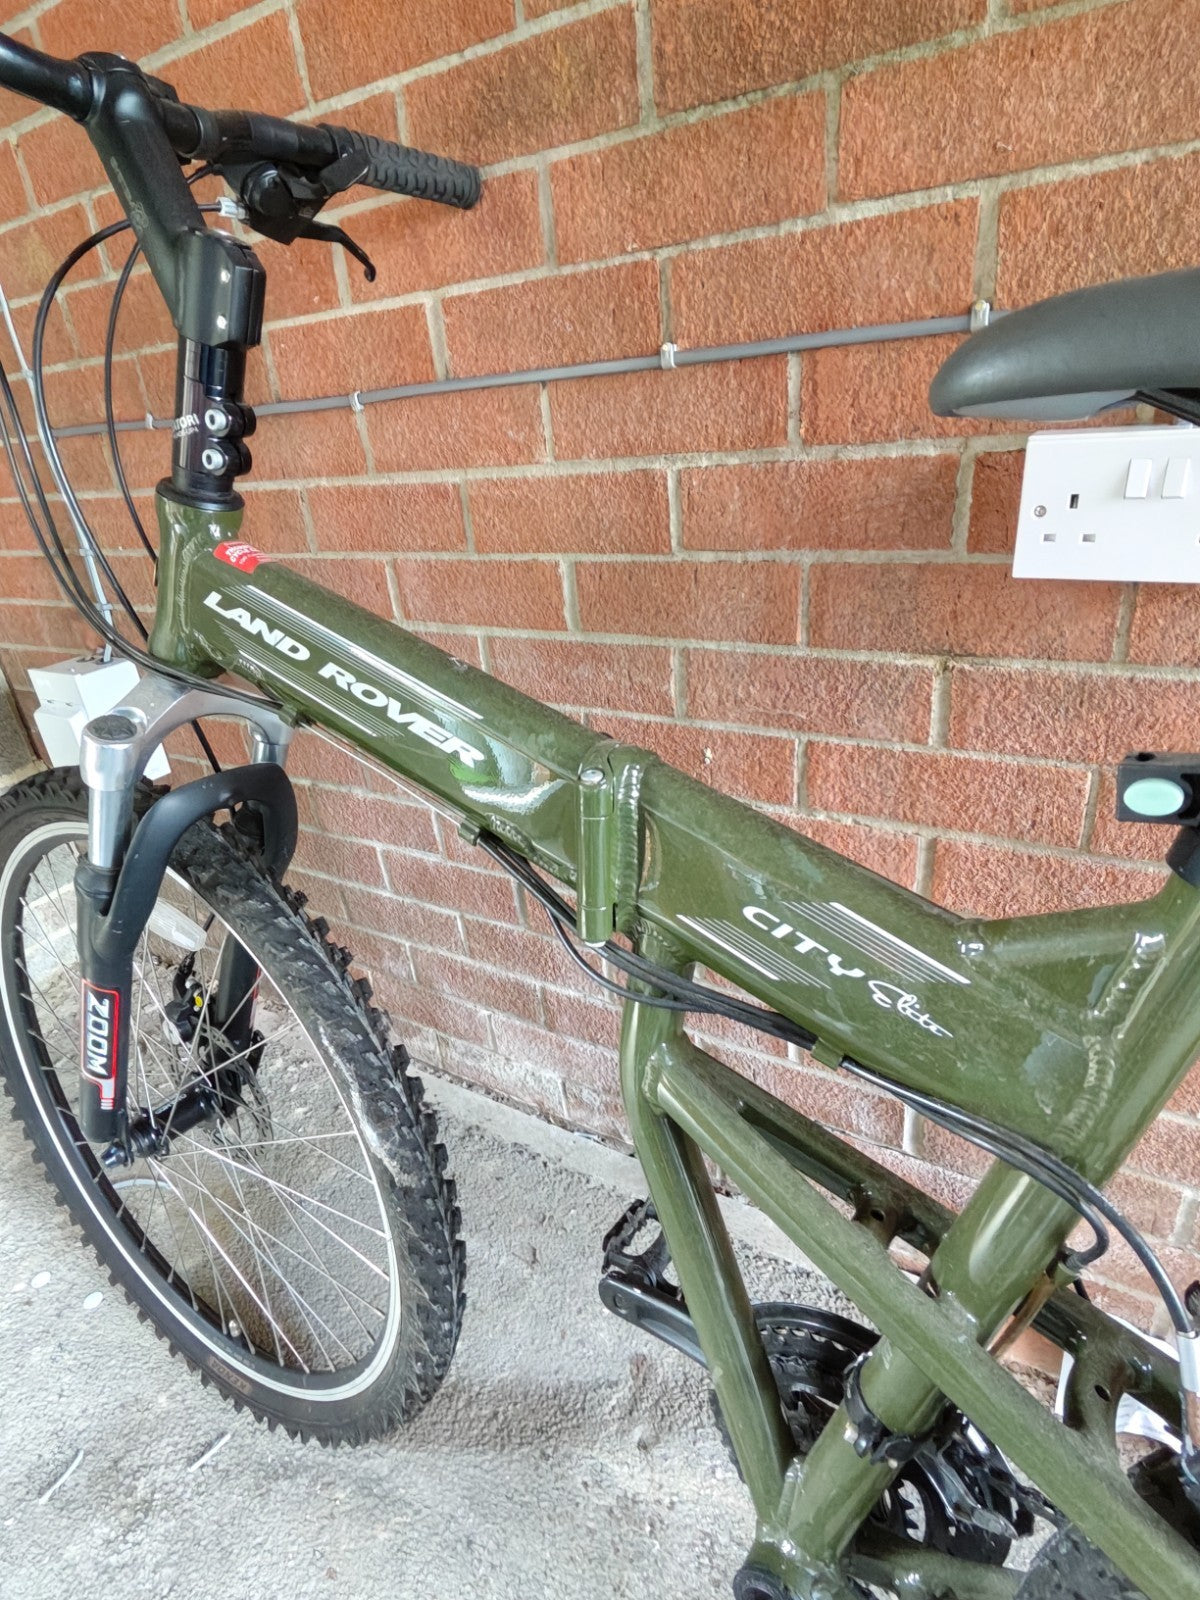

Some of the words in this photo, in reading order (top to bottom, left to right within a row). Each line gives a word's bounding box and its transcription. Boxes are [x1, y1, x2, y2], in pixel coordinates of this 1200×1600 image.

[203, 591, 311, 661] LAND
[318, 661, 485, 768] ROVER
[86, 990, 110, 1076] ZOOM
[742, 906, 865, 978] CITY
[868, 980, 953, 1037] Elite
